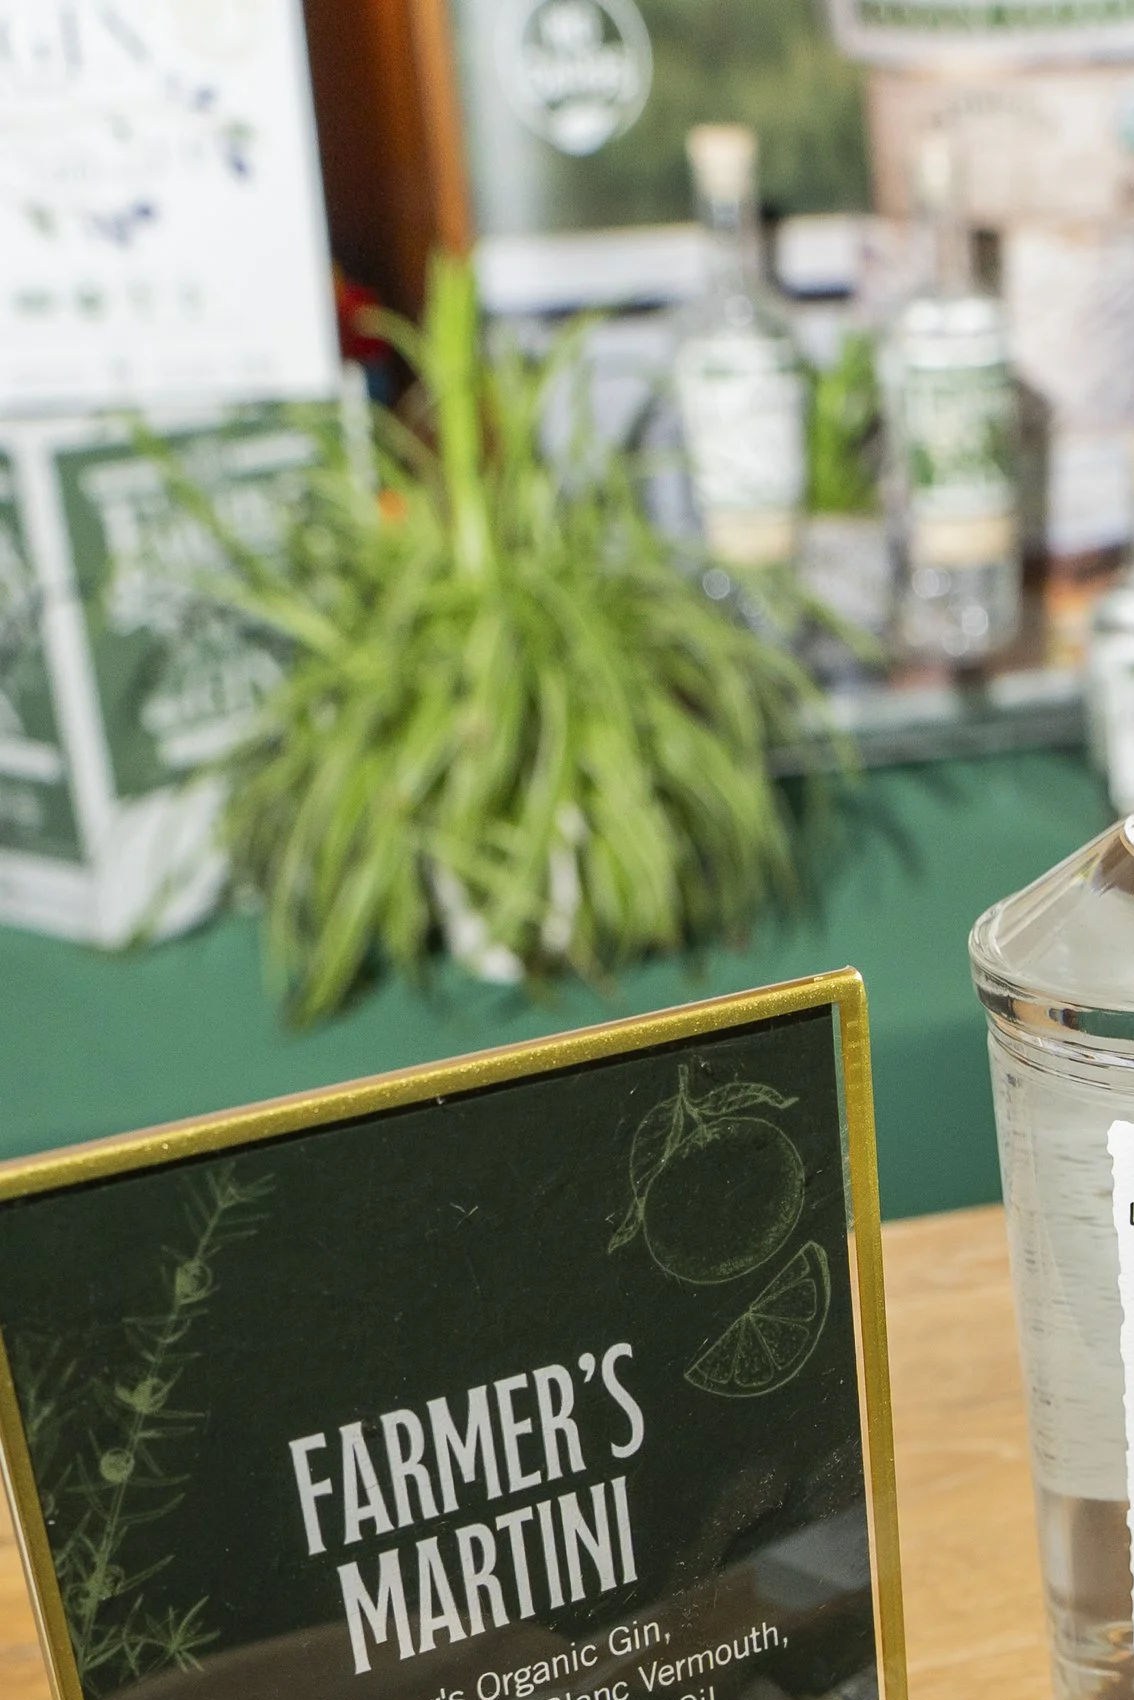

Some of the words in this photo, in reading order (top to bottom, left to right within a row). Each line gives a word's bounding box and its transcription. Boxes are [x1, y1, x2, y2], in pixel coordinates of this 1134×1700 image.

[288, 1342, 645, 1556] FARMER'S
[337, 1475, 637, 1675] MARTINI
[608, 1619, 672, 1657] Gin,
[637, 1621, 789, 1690] Vermouth,
